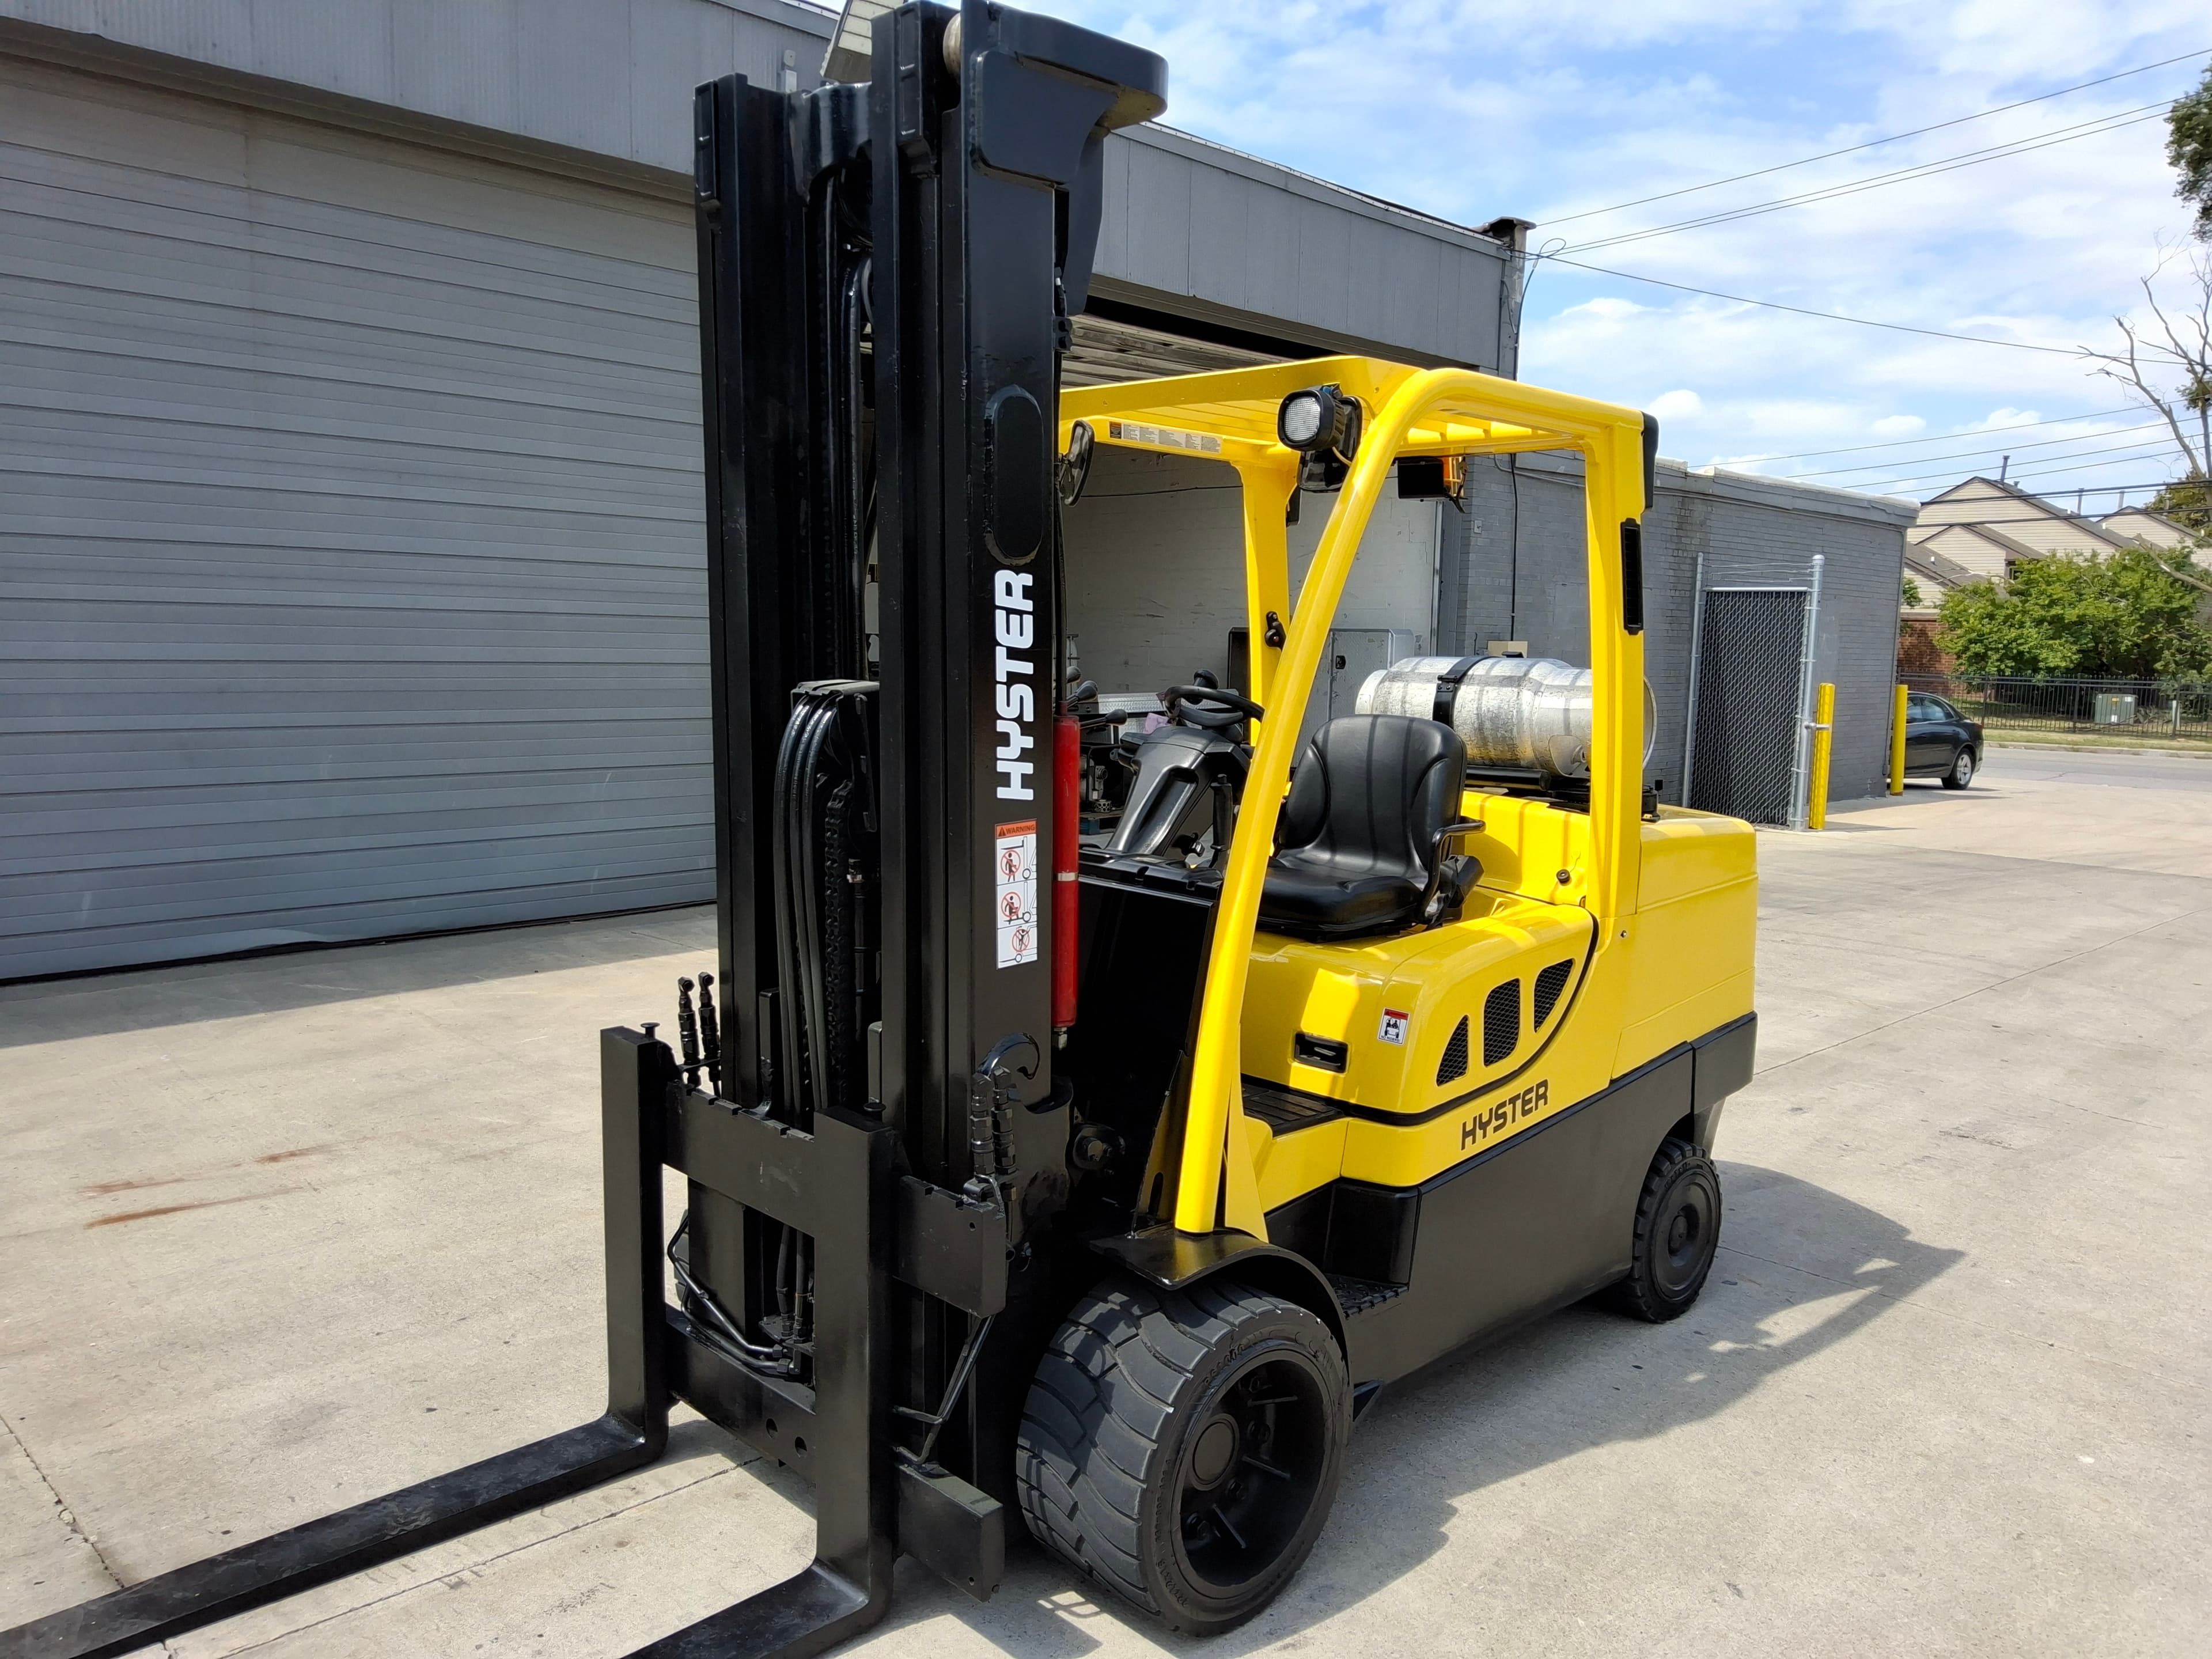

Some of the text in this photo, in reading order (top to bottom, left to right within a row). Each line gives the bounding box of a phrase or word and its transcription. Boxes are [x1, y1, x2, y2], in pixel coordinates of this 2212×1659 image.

[994, 569, 1034, 801] HYSTER
[1005, 824, 1035, 835] WARNING
[1461, 1078, 1548, 1151] HYSTER
